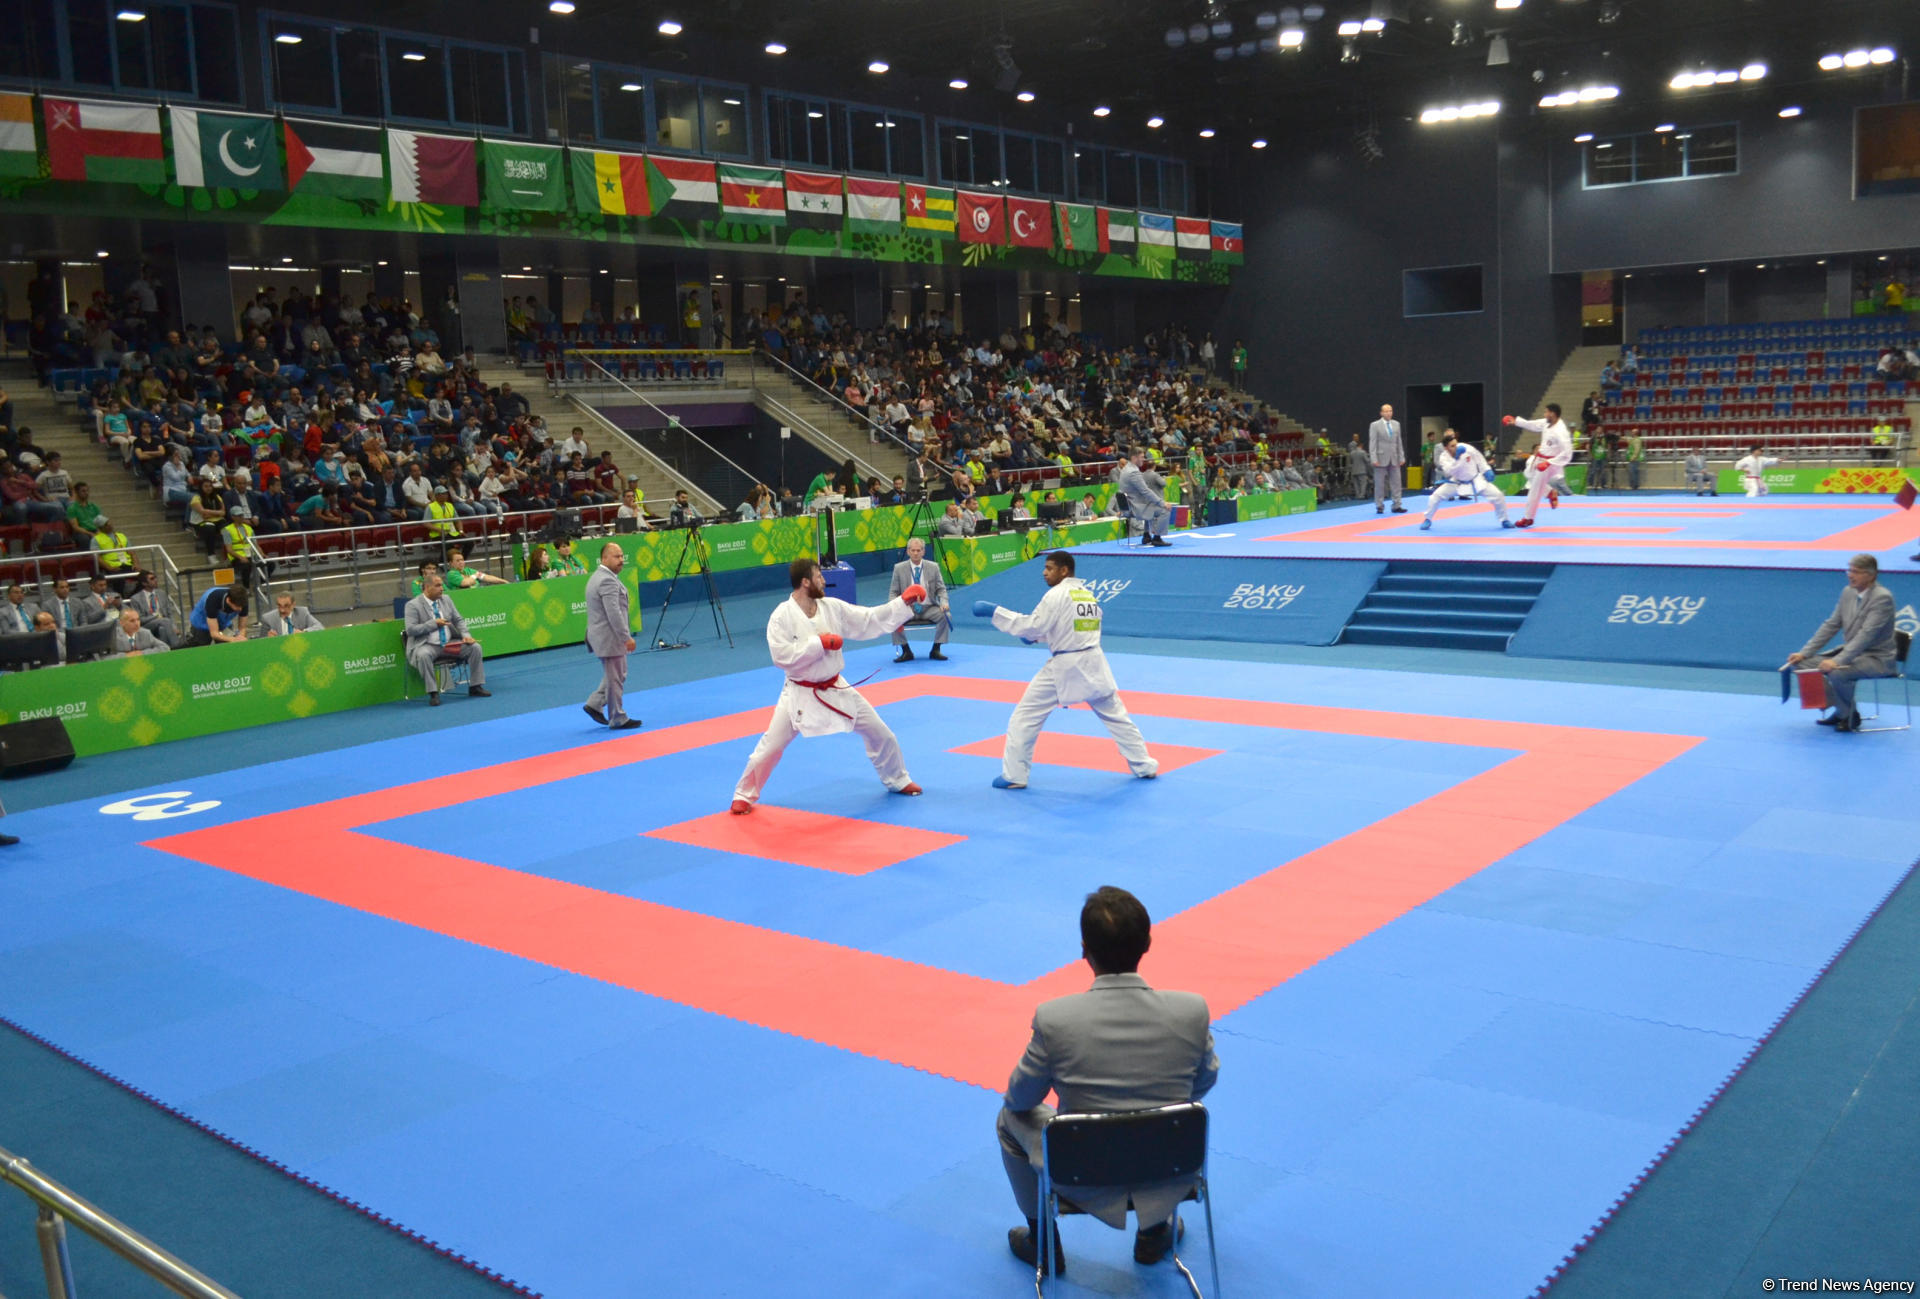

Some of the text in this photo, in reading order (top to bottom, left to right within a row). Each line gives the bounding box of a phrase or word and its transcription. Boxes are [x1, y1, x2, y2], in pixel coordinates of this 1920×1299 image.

[1233, 583, 1305, 597] BAKU
[1223, 595, 1295, 609] 2017
[1615, 594, 1706, 610] BAKU
[464, 615, 485, 625] BAKU
[487, 612, 506, 622] 2017
[1607, 609, 1698, 625] 2017
[344, 658, 369, 670] BAKU
[372, 653, 396, 664] 2017
[192, 681, 221, 693] BAKU
[224, 676, 251, 688] 2017
[20, 707, 53, 721] BAKU
[56, 701, 87, 716] 2017
[99, 791, 222, 821] 3
